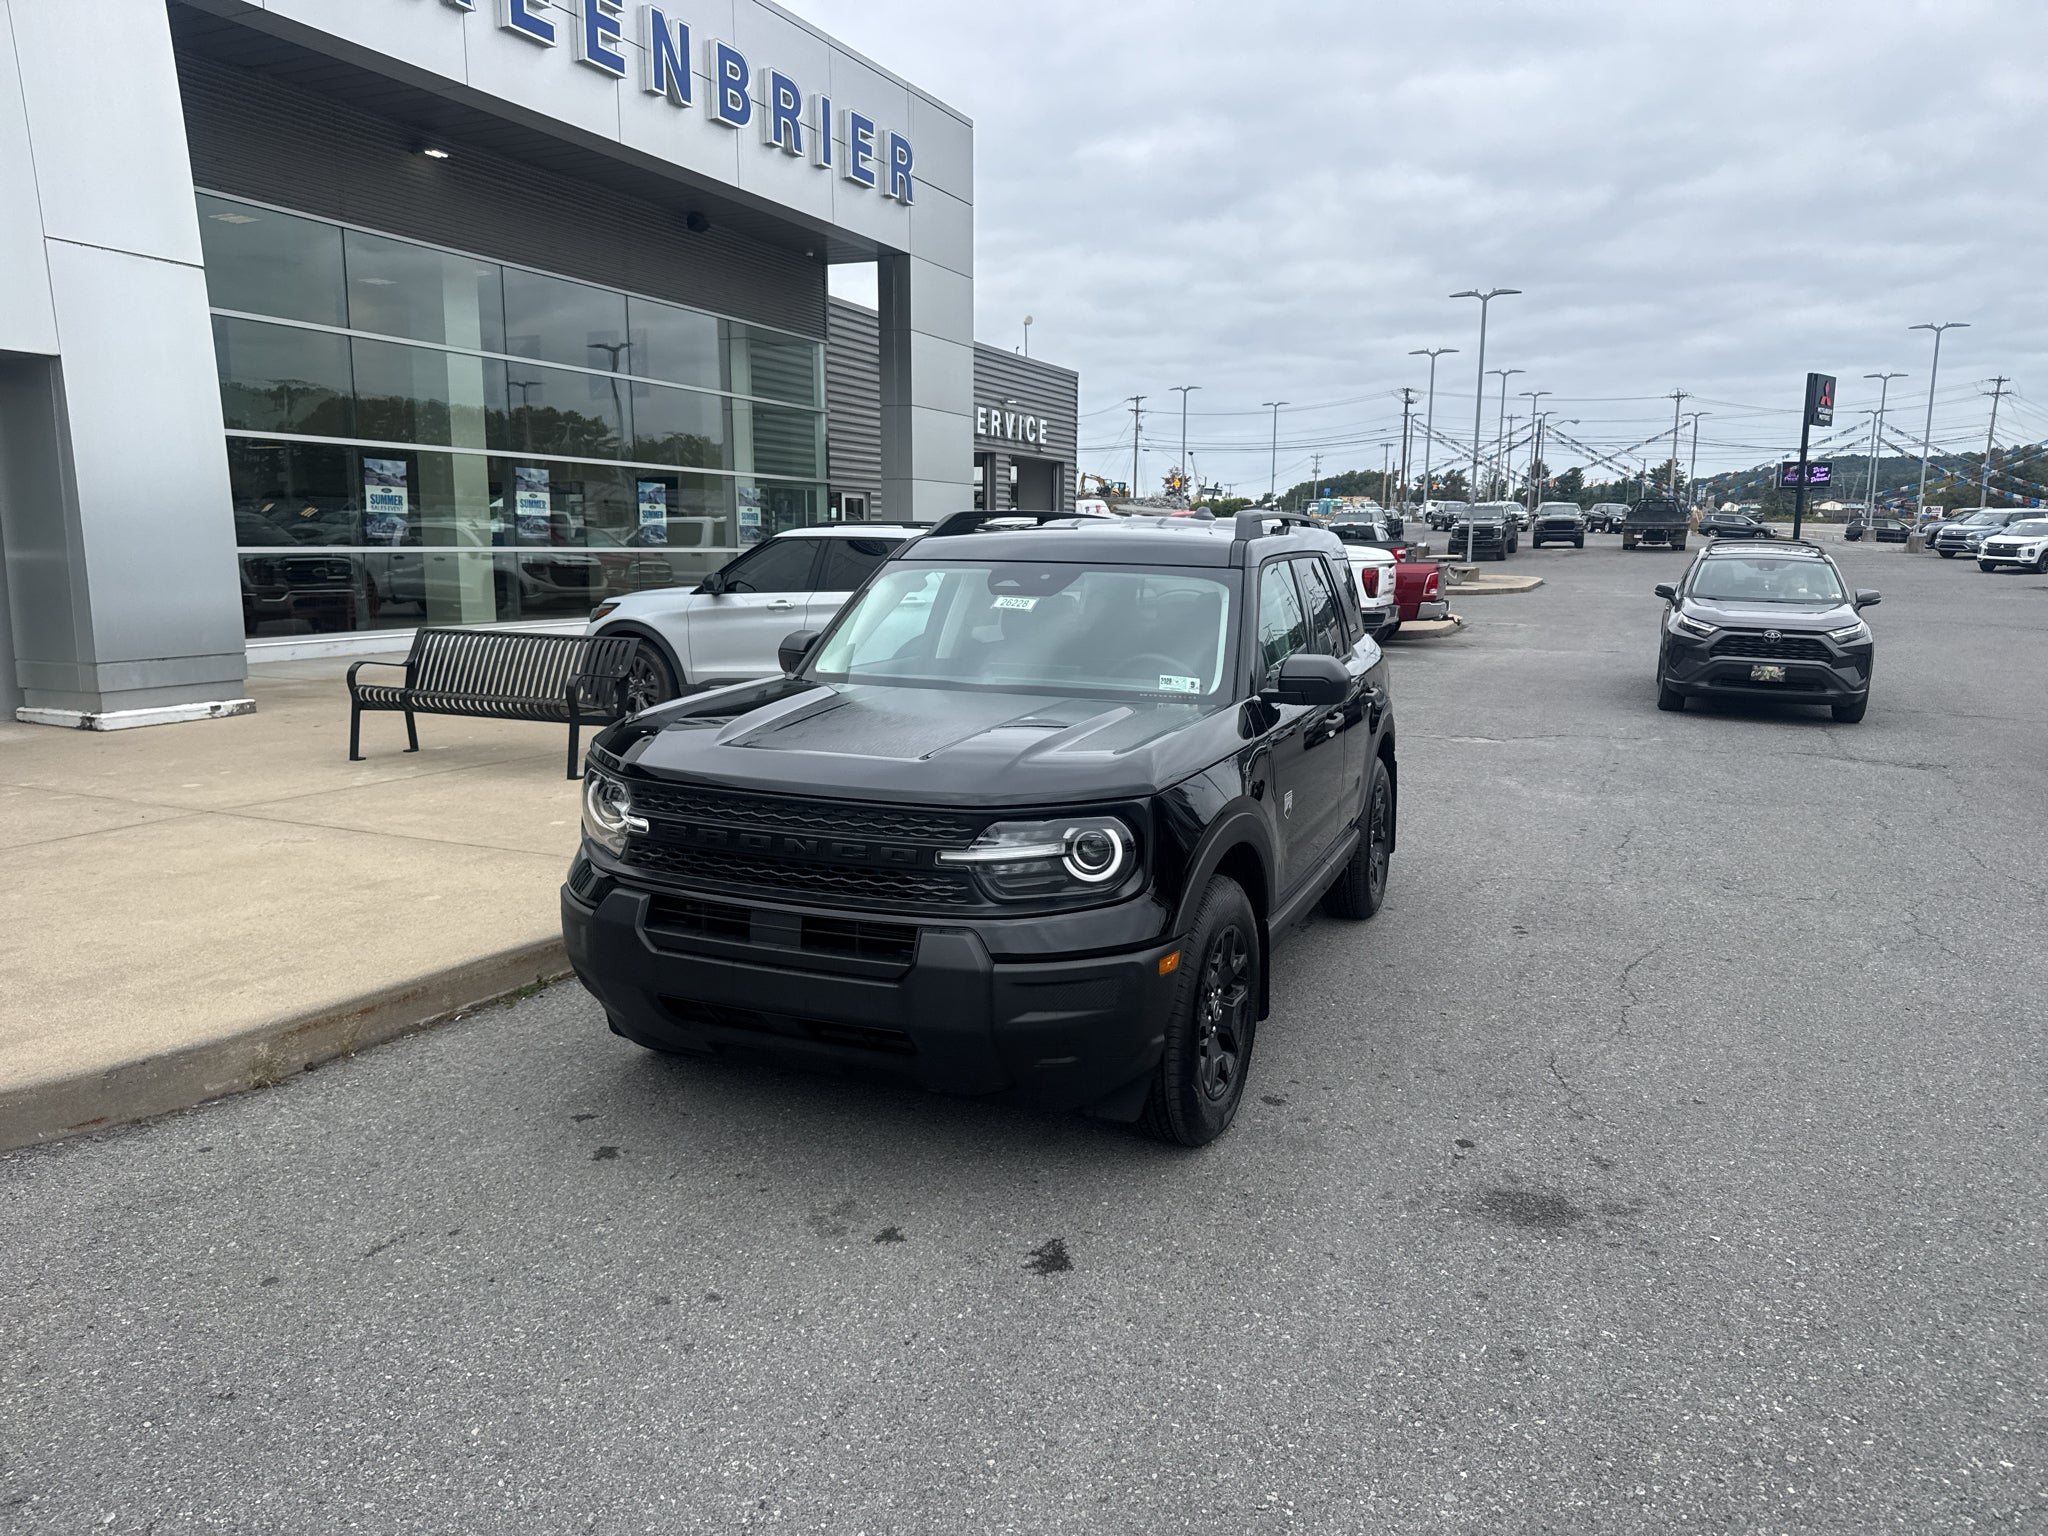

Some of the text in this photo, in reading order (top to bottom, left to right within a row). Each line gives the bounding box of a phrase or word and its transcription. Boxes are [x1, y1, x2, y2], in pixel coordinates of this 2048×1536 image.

[444, 0, 914, 206] ENBRIER
[977, 406, 1047, 444] ERVICE
[370, 493, 403, 506] SUMMER
[520, 499, 547, 509] SUMMER
[1000, 598, 1030, 608] 26228
[656, 822, 920, 864] BRONCO
